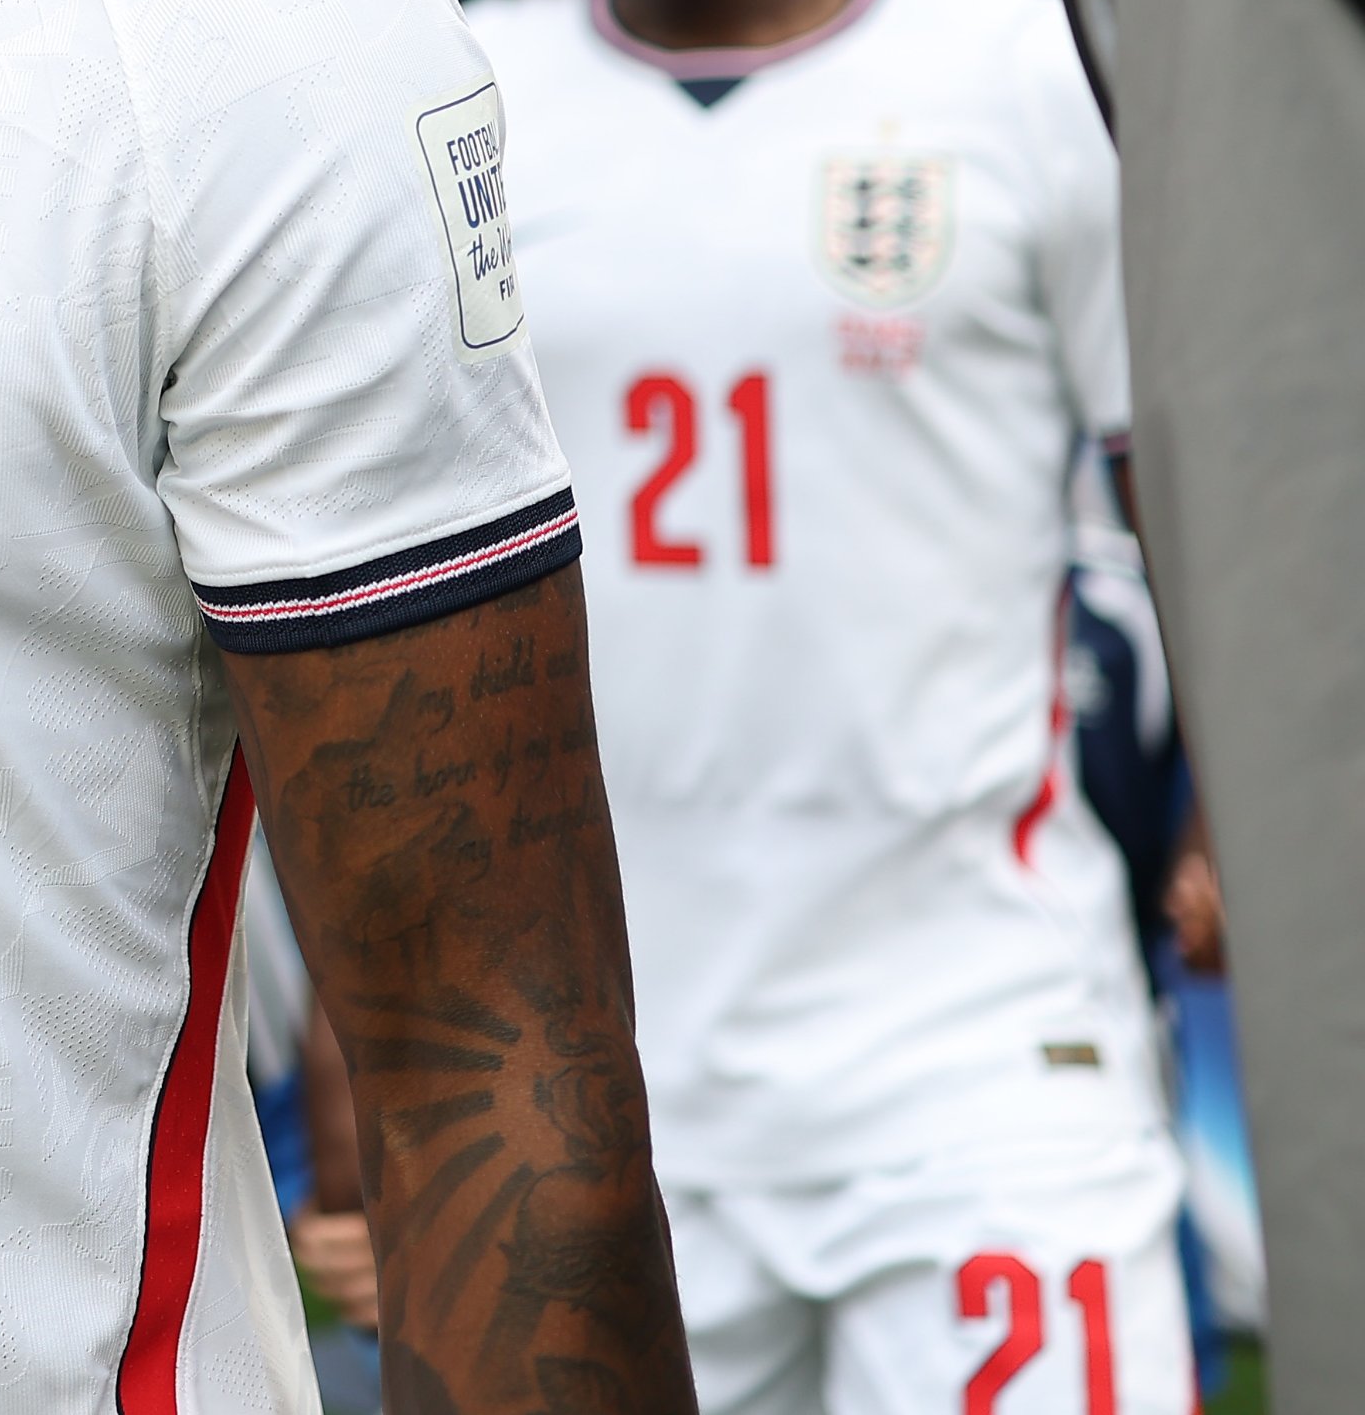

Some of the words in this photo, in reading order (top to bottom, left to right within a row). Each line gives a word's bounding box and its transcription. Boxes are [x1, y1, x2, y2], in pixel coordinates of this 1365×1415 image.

[467, 233, 499, 281] the
[623, 368, 777, 572] 21
[953, 1252, 1119, 1415] 21
